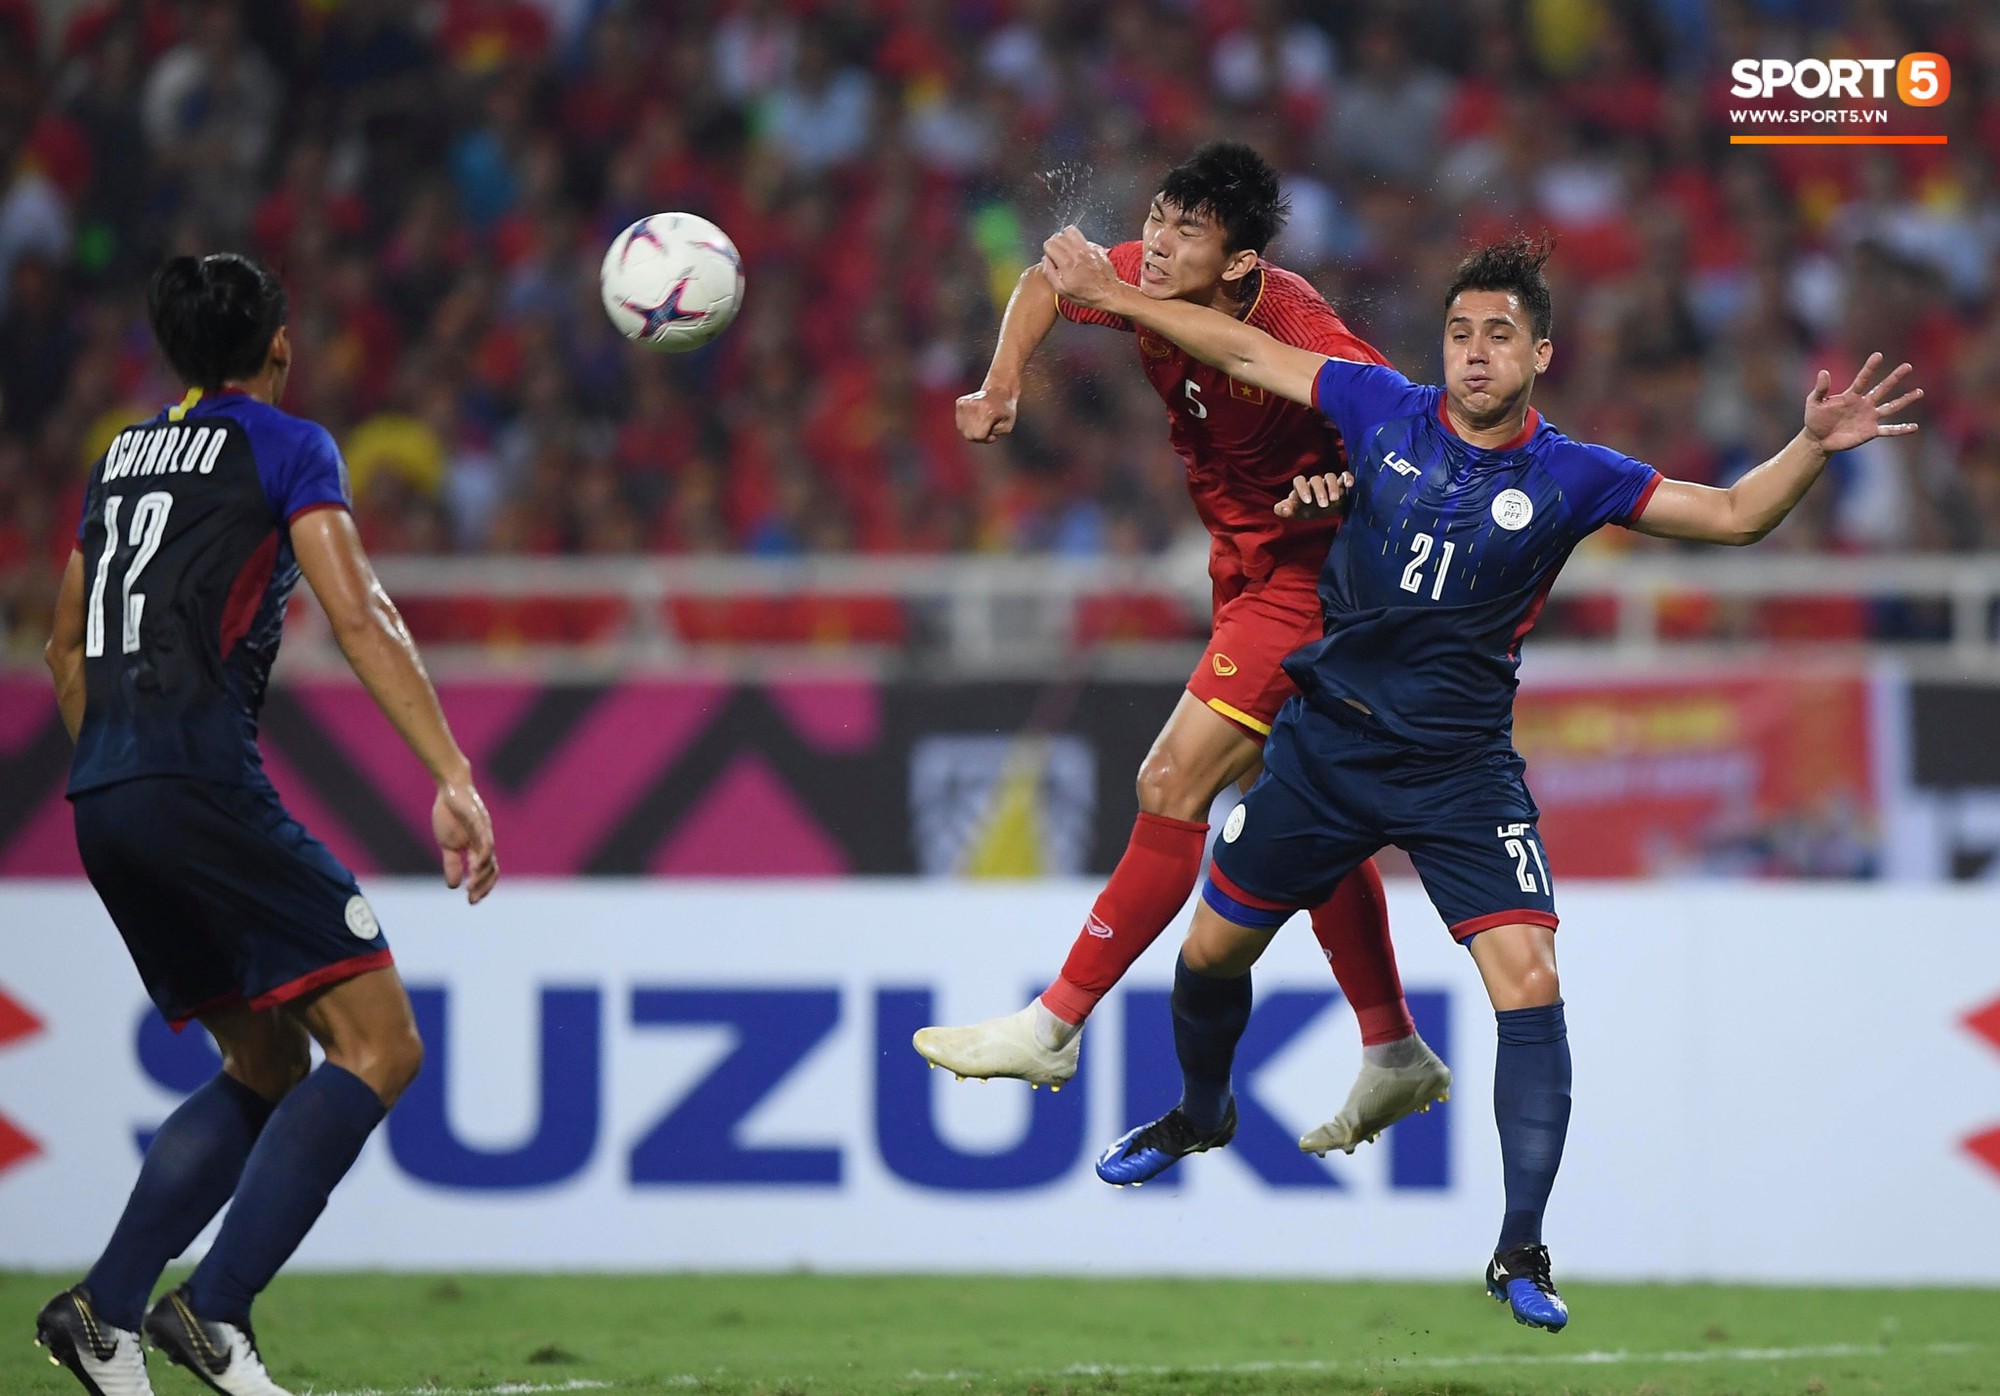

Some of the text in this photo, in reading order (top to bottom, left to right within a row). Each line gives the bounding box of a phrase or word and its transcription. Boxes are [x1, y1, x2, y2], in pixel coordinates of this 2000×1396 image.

[1185, 379, 1208, 419] 5
[101, 426, 228, 484] AGUINALDO
[1503, 511, 1522, 519] PFF
[86, 491, 174, 657] 12
[1400, 532, 1455, 601] 21
[1504, 839, 1550, 896] 21
